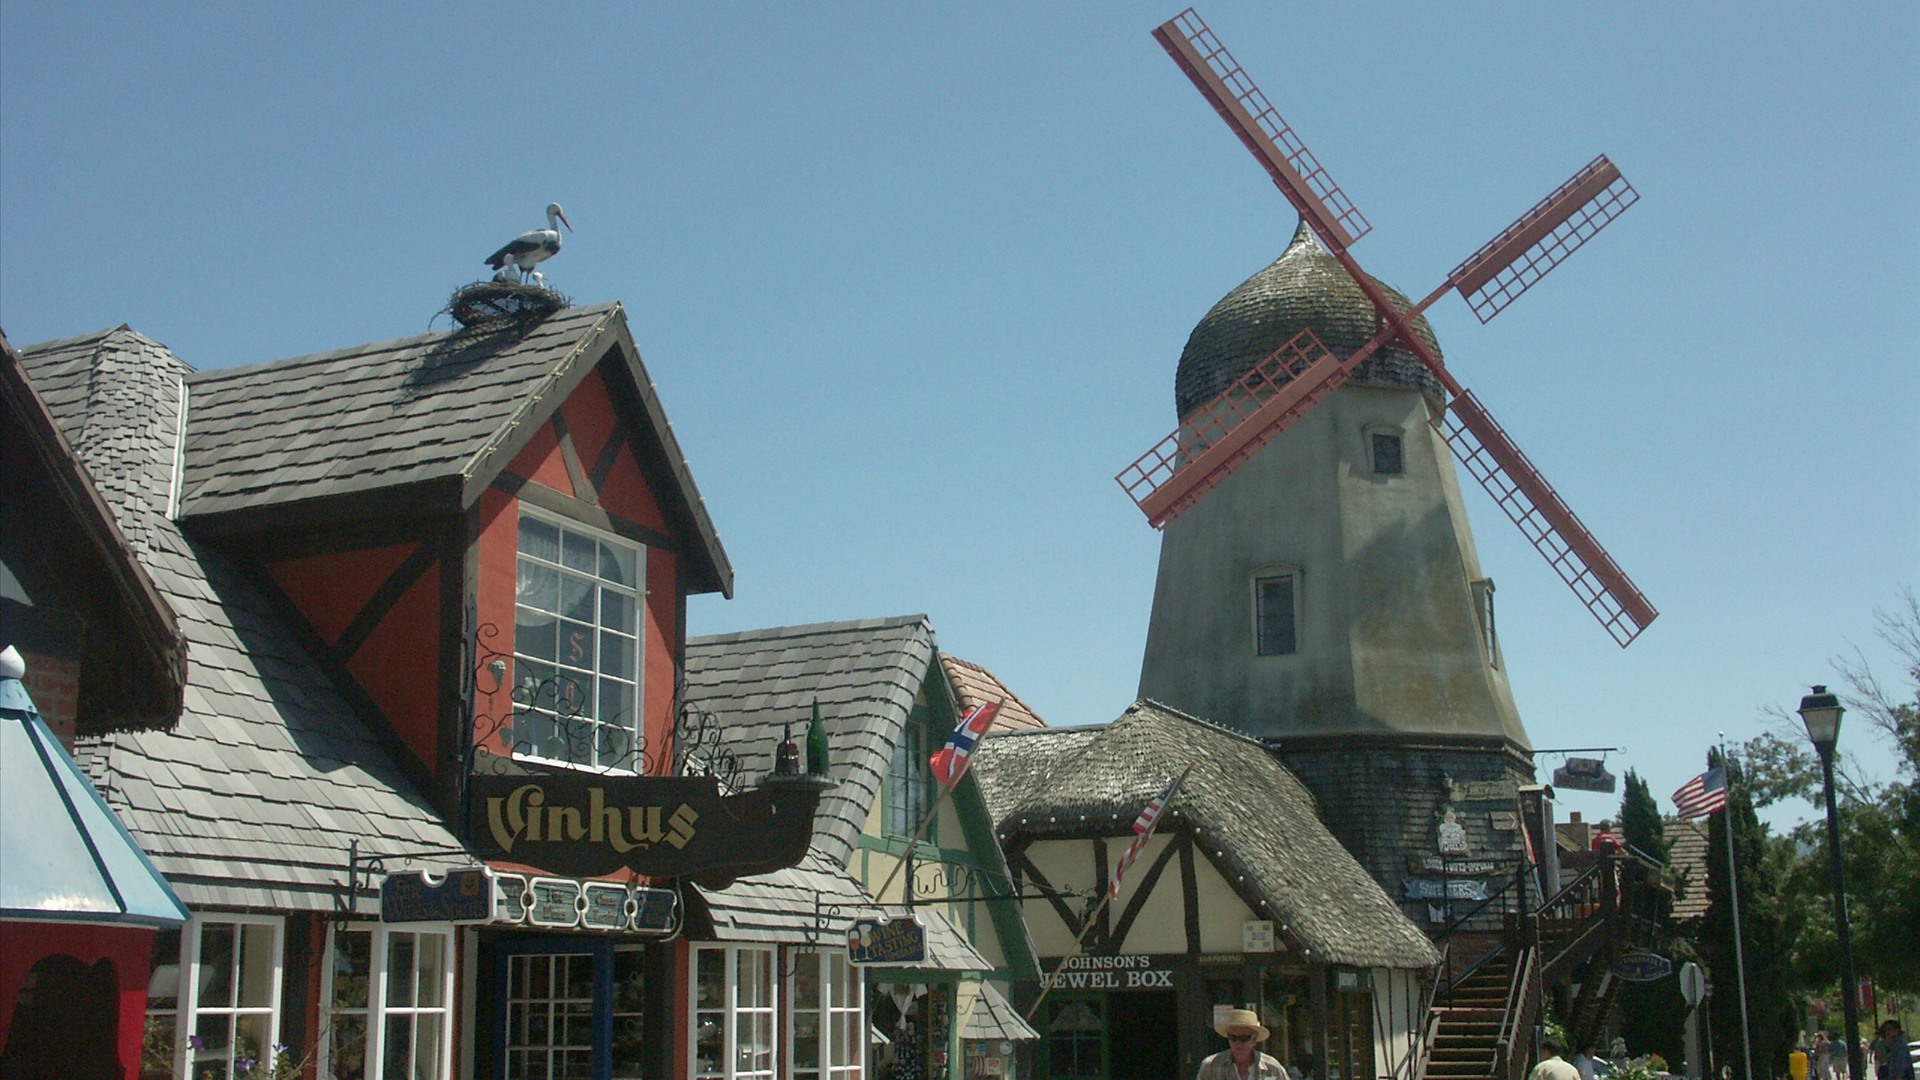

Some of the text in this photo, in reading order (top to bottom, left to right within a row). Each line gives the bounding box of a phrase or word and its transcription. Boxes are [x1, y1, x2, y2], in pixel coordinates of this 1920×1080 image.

[487, 784, 700, 853] Vinhus
[869, 920, 905, 943] WINE
[868, 931, 920, 957] TASTING
[1062, 956, 1150, 969] JOHNSON'S
[1040, 970, 1174, 988] JEWEL BOX
